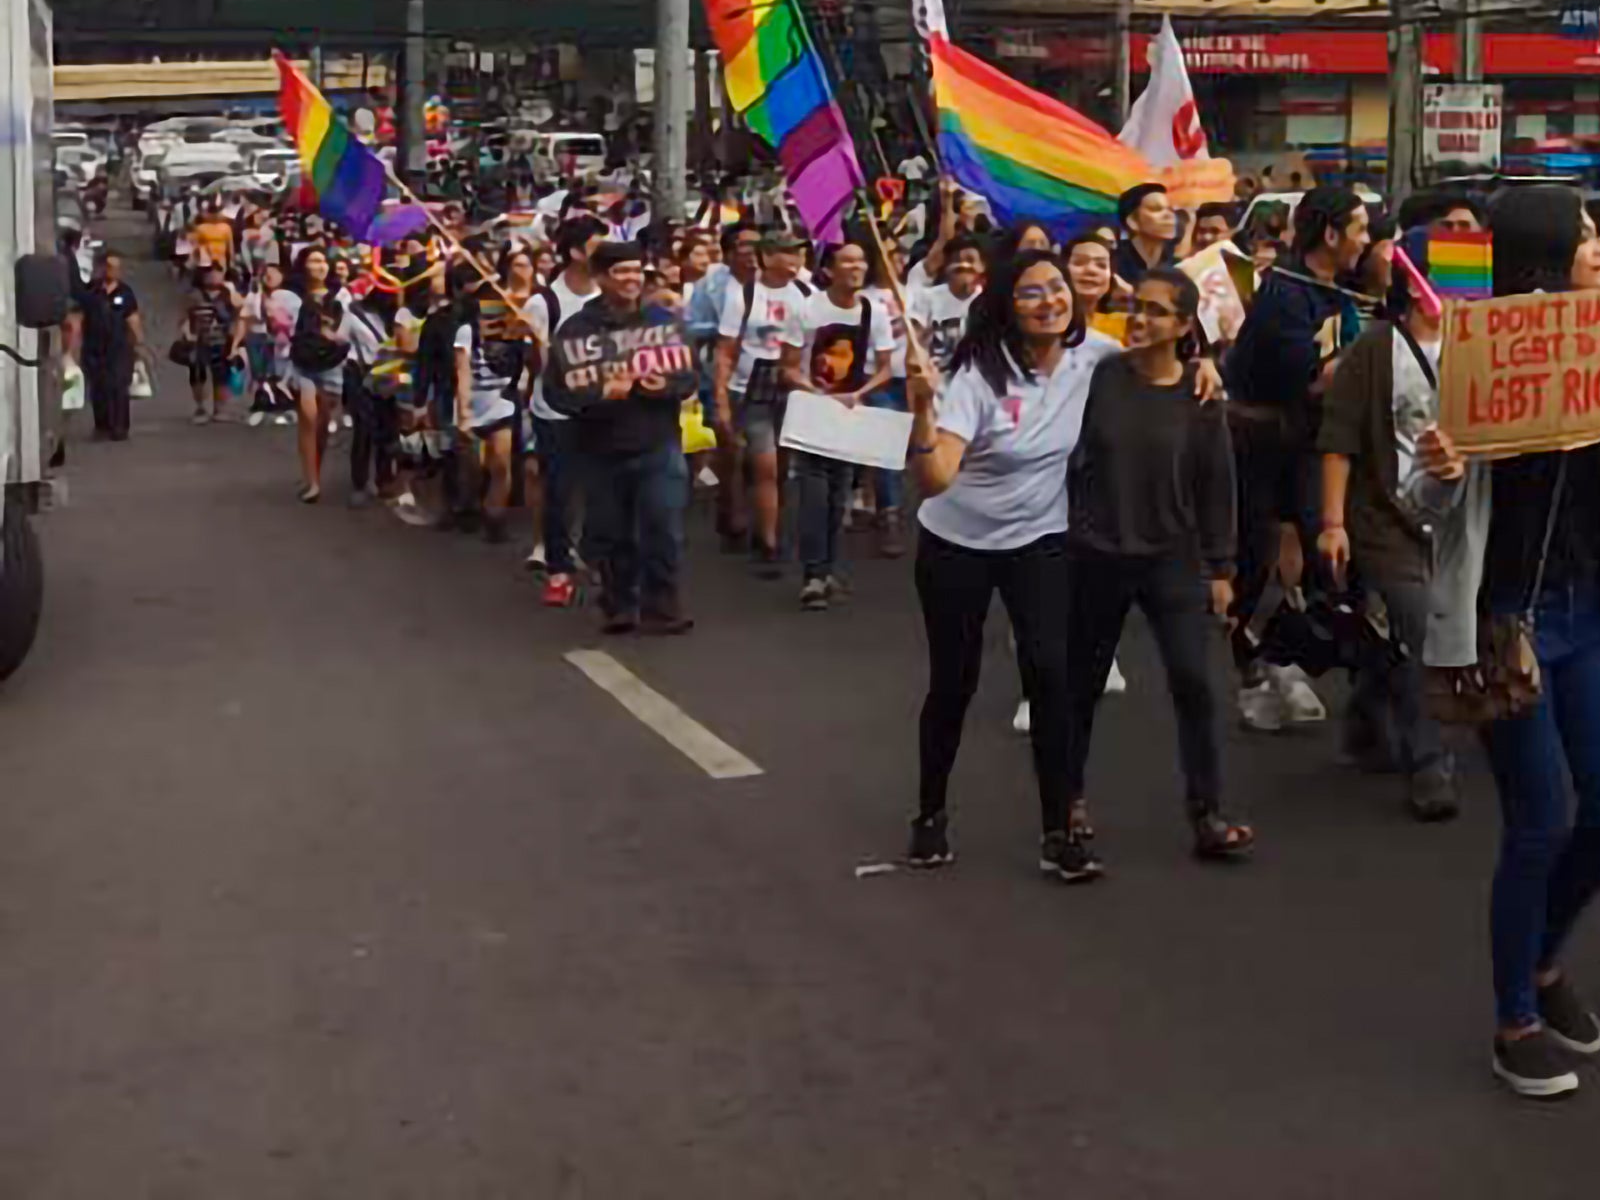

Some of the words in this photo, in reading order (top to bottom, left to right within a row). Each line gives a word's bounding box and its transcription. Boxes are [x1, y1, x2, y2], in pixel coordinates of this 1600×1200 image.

[1457, 307, 1472, 341] I
[1491, 331, 1565, 369] LGBT
[1468, 372, 1551, 427] LGBT
